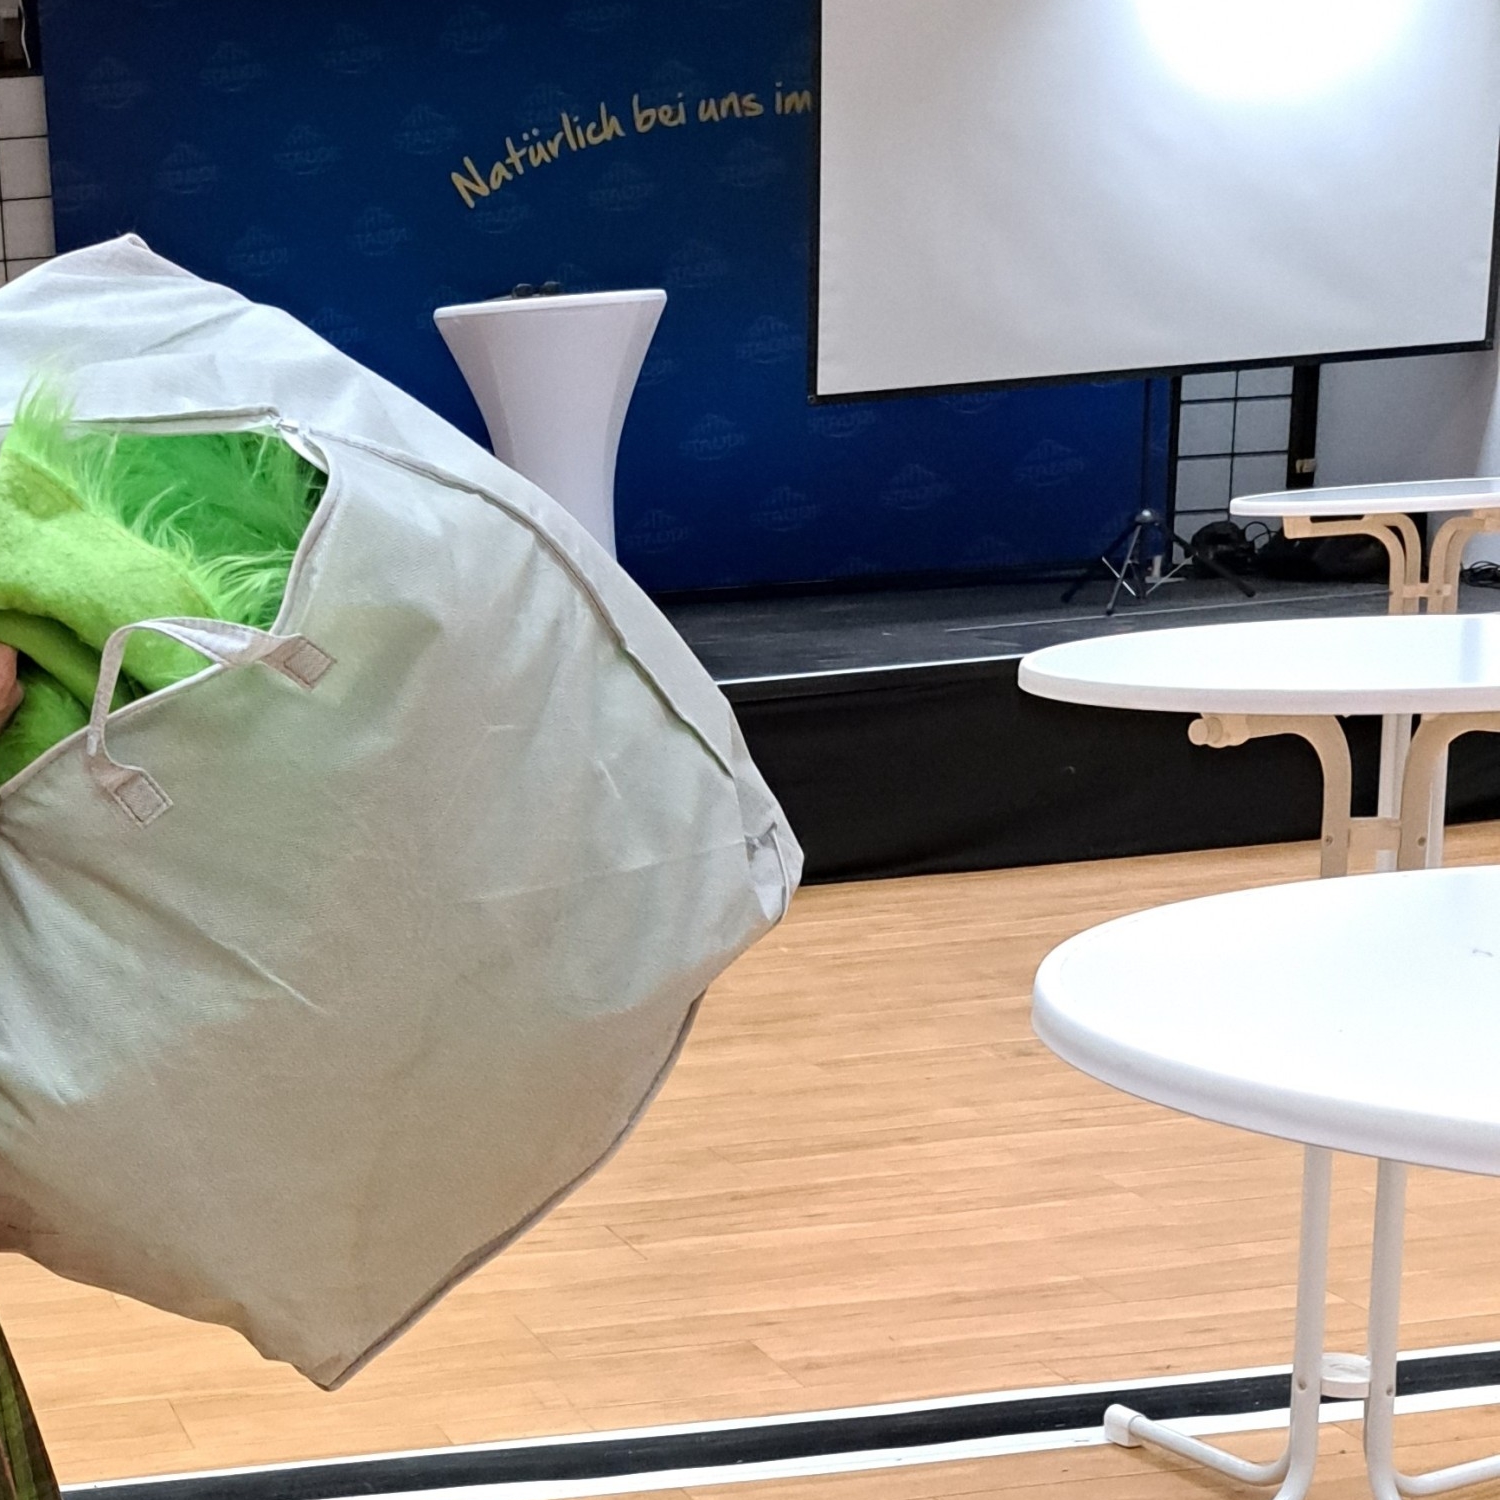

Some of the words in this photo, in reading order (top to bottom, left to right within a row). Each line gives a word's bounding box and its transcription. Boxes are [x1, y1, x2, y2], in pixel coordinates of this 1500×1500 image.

[450, 100, 626, 209] Natürlich
[632, 91, 687, 134] bei
[697, 90, 764, 124] uns
[774, 80, 812, 116] im
